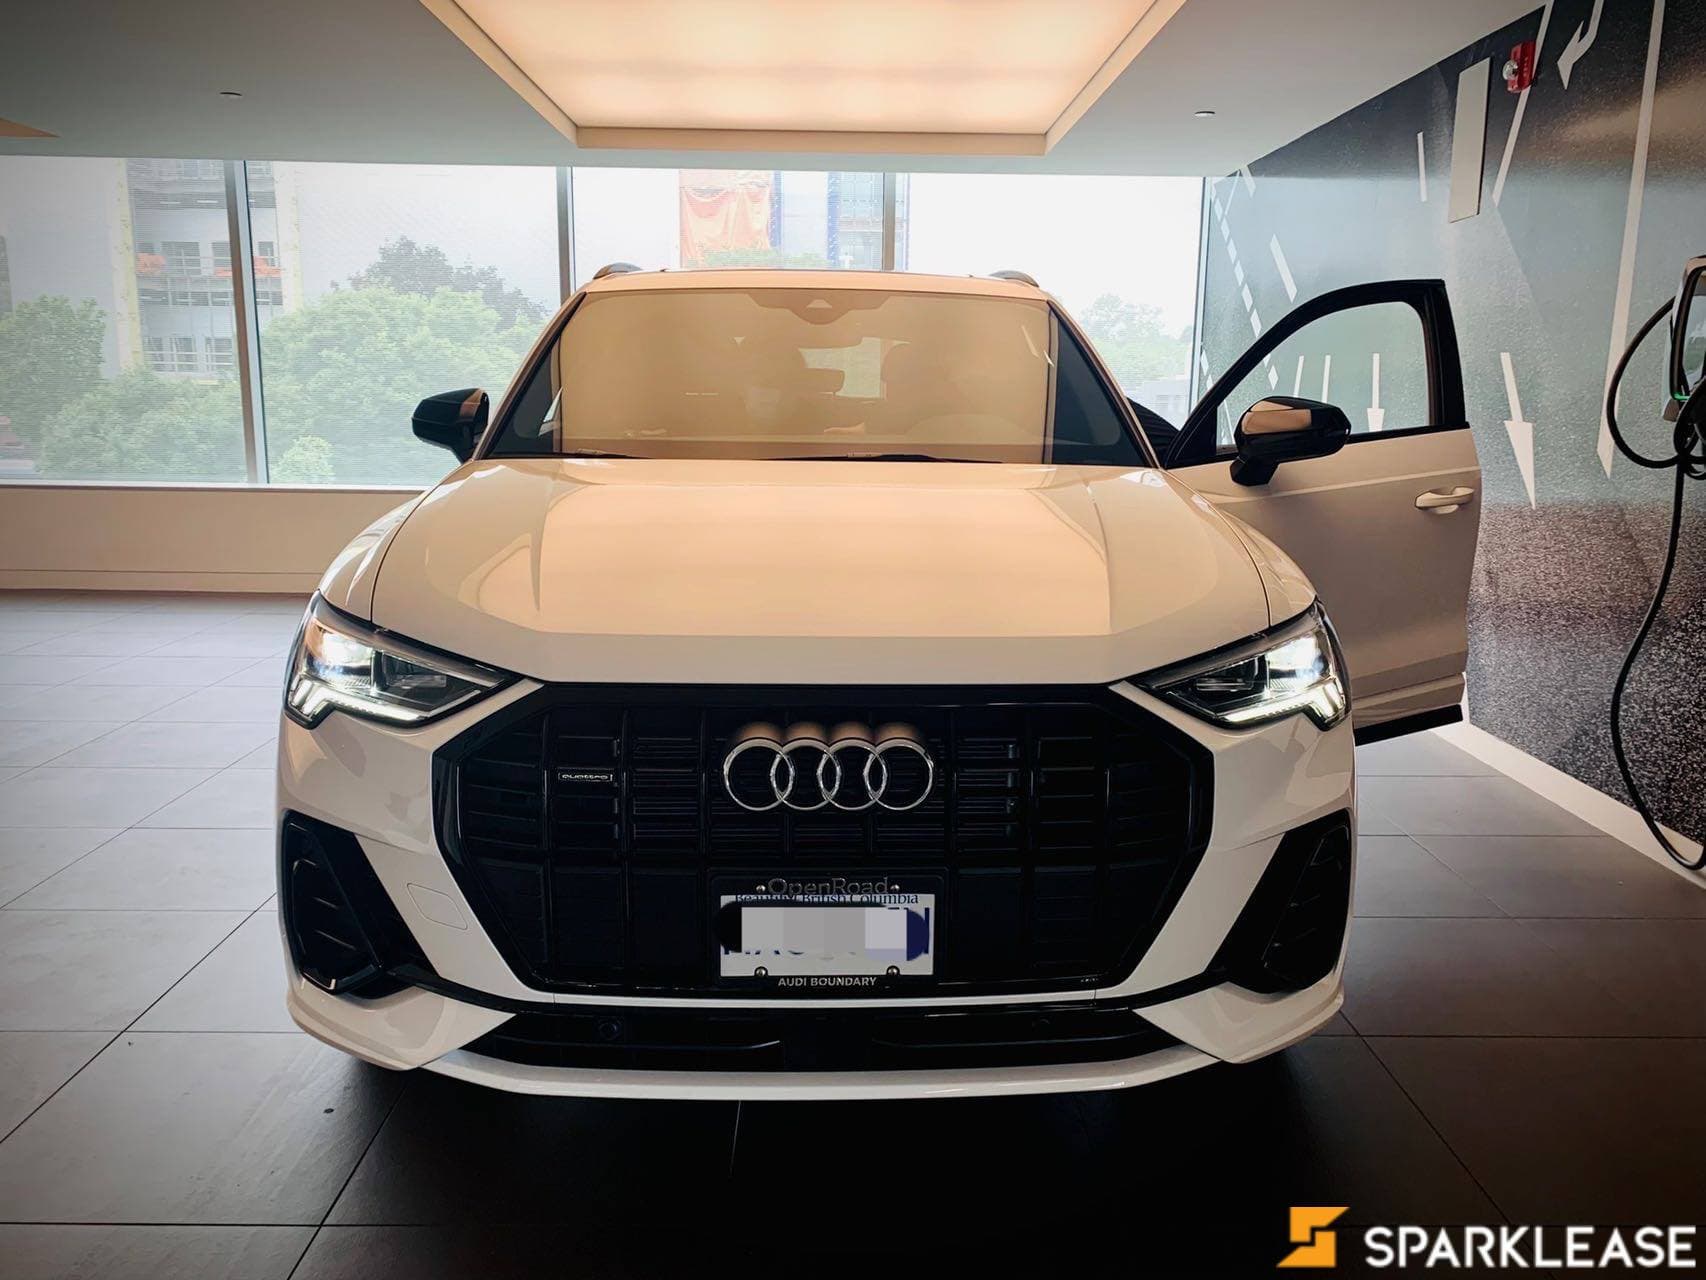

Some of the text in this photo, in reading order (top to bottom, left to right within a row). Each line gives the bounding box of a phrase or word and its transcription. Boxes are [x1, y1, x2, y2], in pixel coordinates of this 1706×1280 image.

[767, 877, 889, 896] OpenRoad
[778, 976, 877, 987] AUDI BOUNDARY
